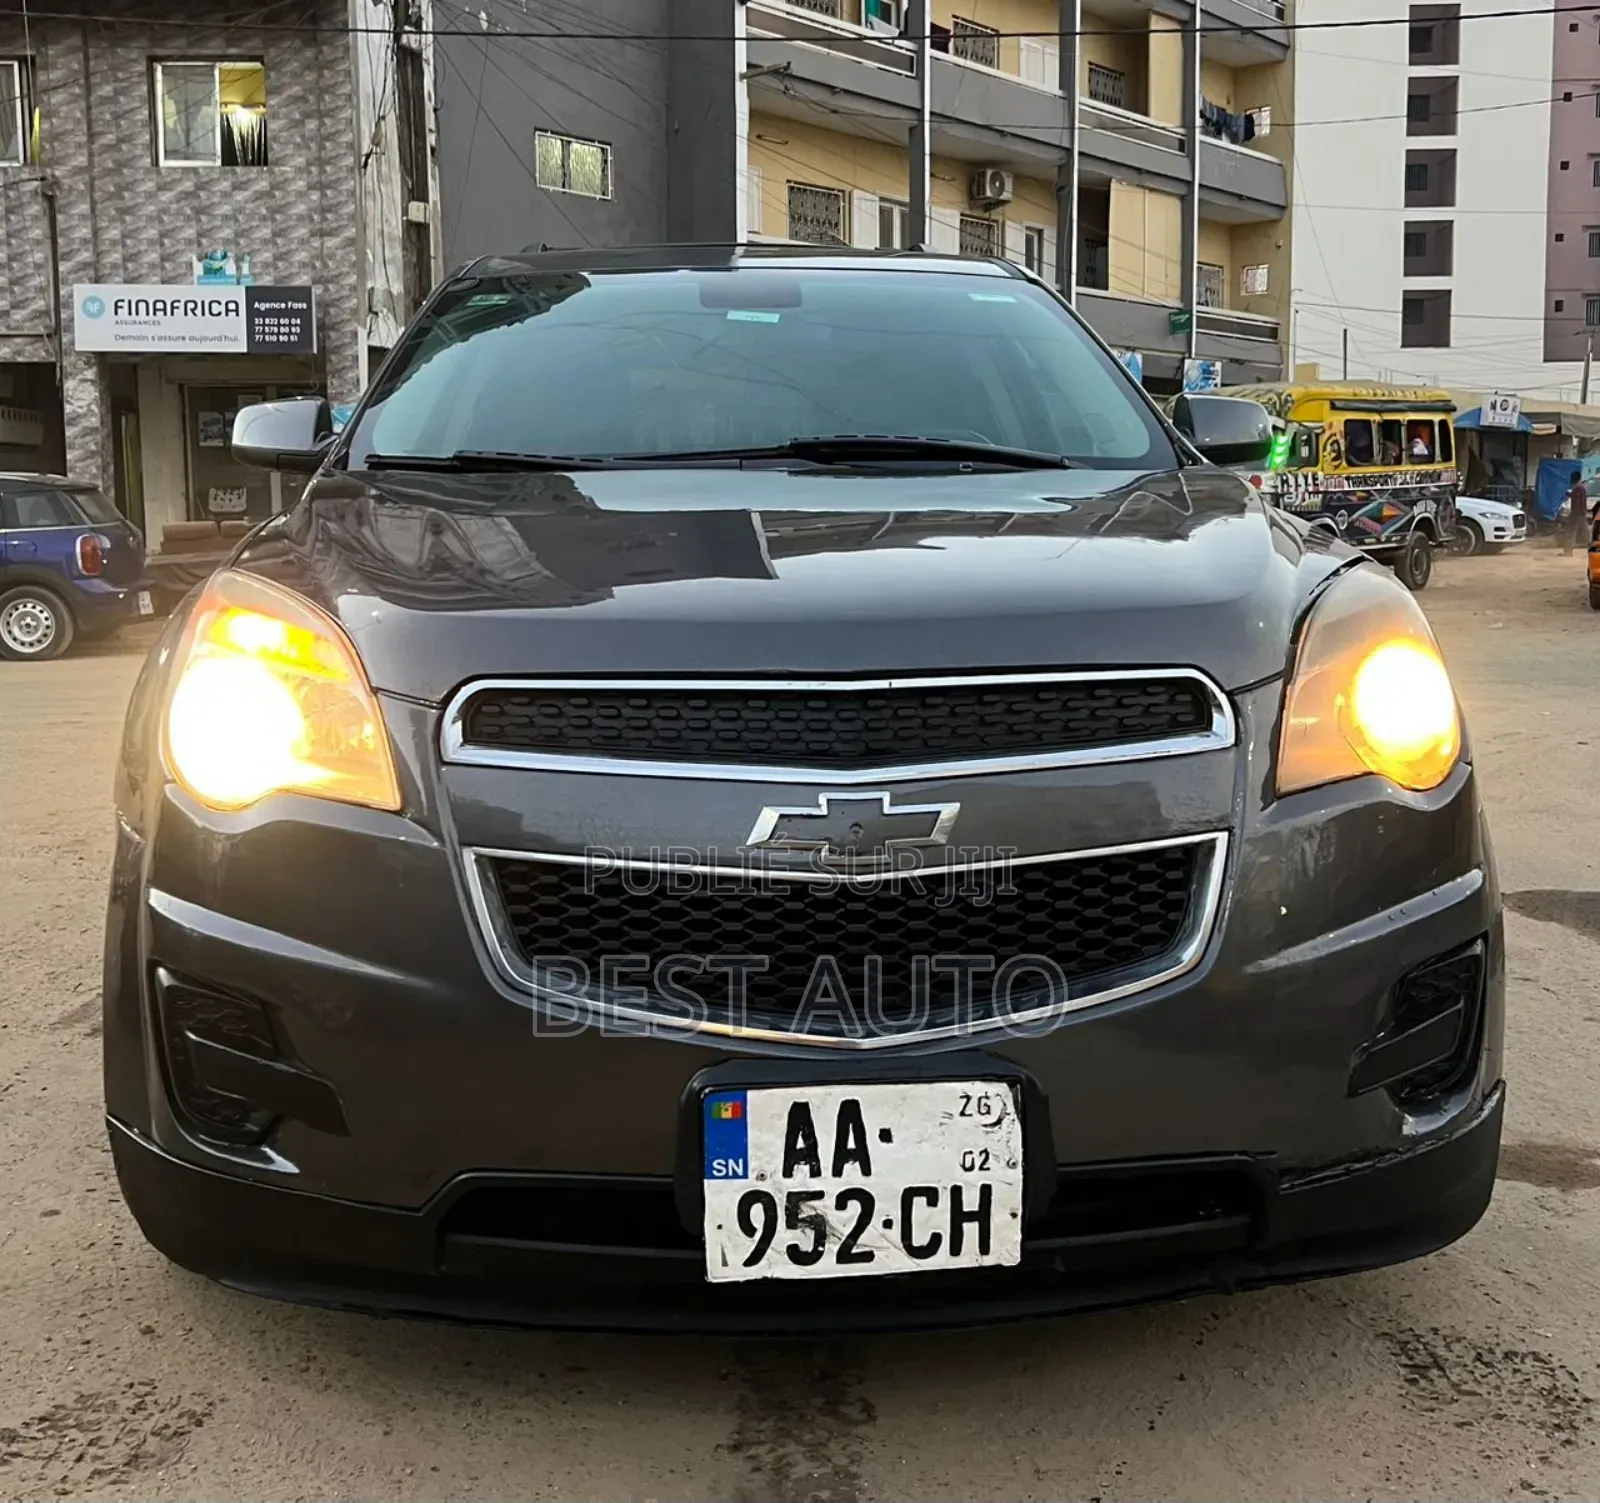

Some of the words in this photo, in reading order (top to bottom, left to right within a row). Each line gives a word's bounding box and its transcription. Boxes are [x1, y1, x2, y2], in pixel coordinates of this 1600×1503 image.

[114, 299, 240, 317] FINAFRICA
[254, 301, 286, 311] Agence
[254, 326, 263, 334] 77
[254, 334, 263, 342] 77
[959, 1094, 992, 1117] ZG
[712, 1158, 744, 1177] SN
[960, 1149, 991, 1172] 02
